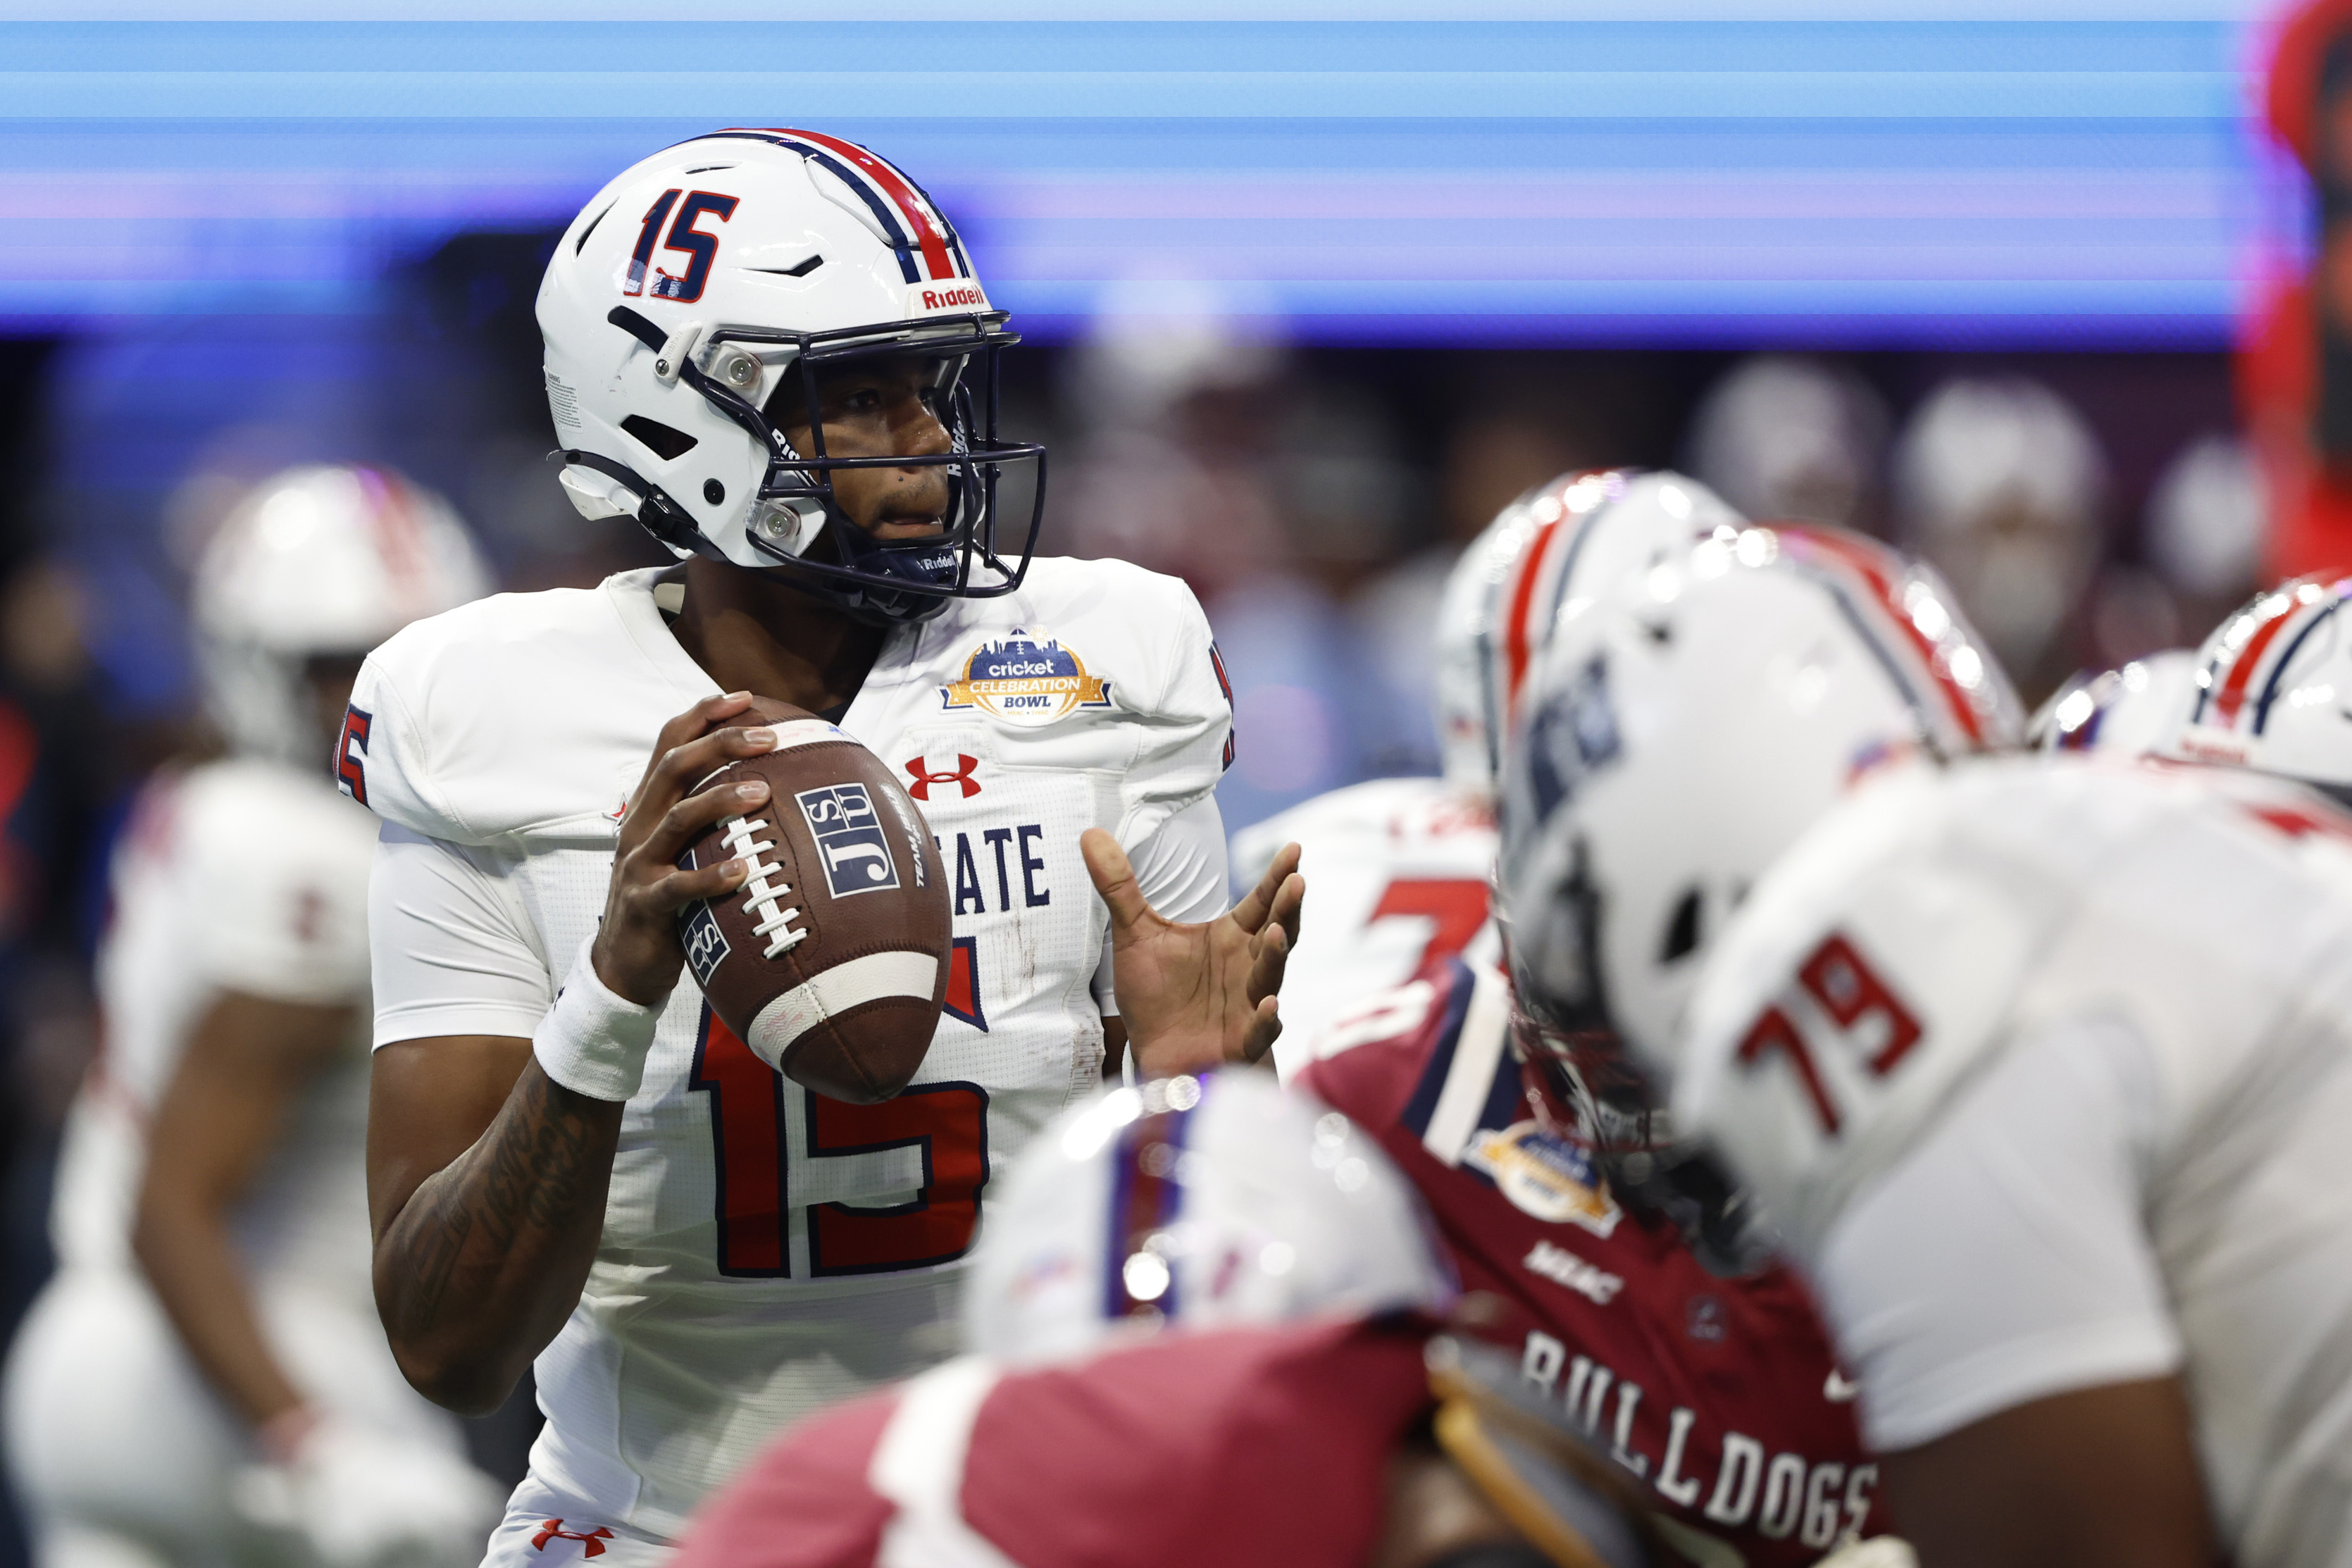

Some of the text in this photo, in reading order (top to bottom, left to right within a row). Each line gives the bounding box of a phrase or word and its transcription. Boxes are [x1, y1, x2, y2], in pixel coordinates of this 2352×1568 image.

[623, 189, 740, 304] 15
[922, 285, 984, 309] Riddell
[922, 554, 956, 571] Riddell
[969, 678, 1081, 694] CELEBRATION
[988, 659, 1054, 677] cricket
[1003, 696, 1051, 708] BOWL
[908, 835, 924, 888] TEAM
[935, 824, 1050, 916] ATE
[1367, 875, 1495, 993] 7
[1733, 928, 1922, 1140] 79
[688, 937, 990, 1278] 15
[1522, 1329, 1879, 1550] BULLDOGS
